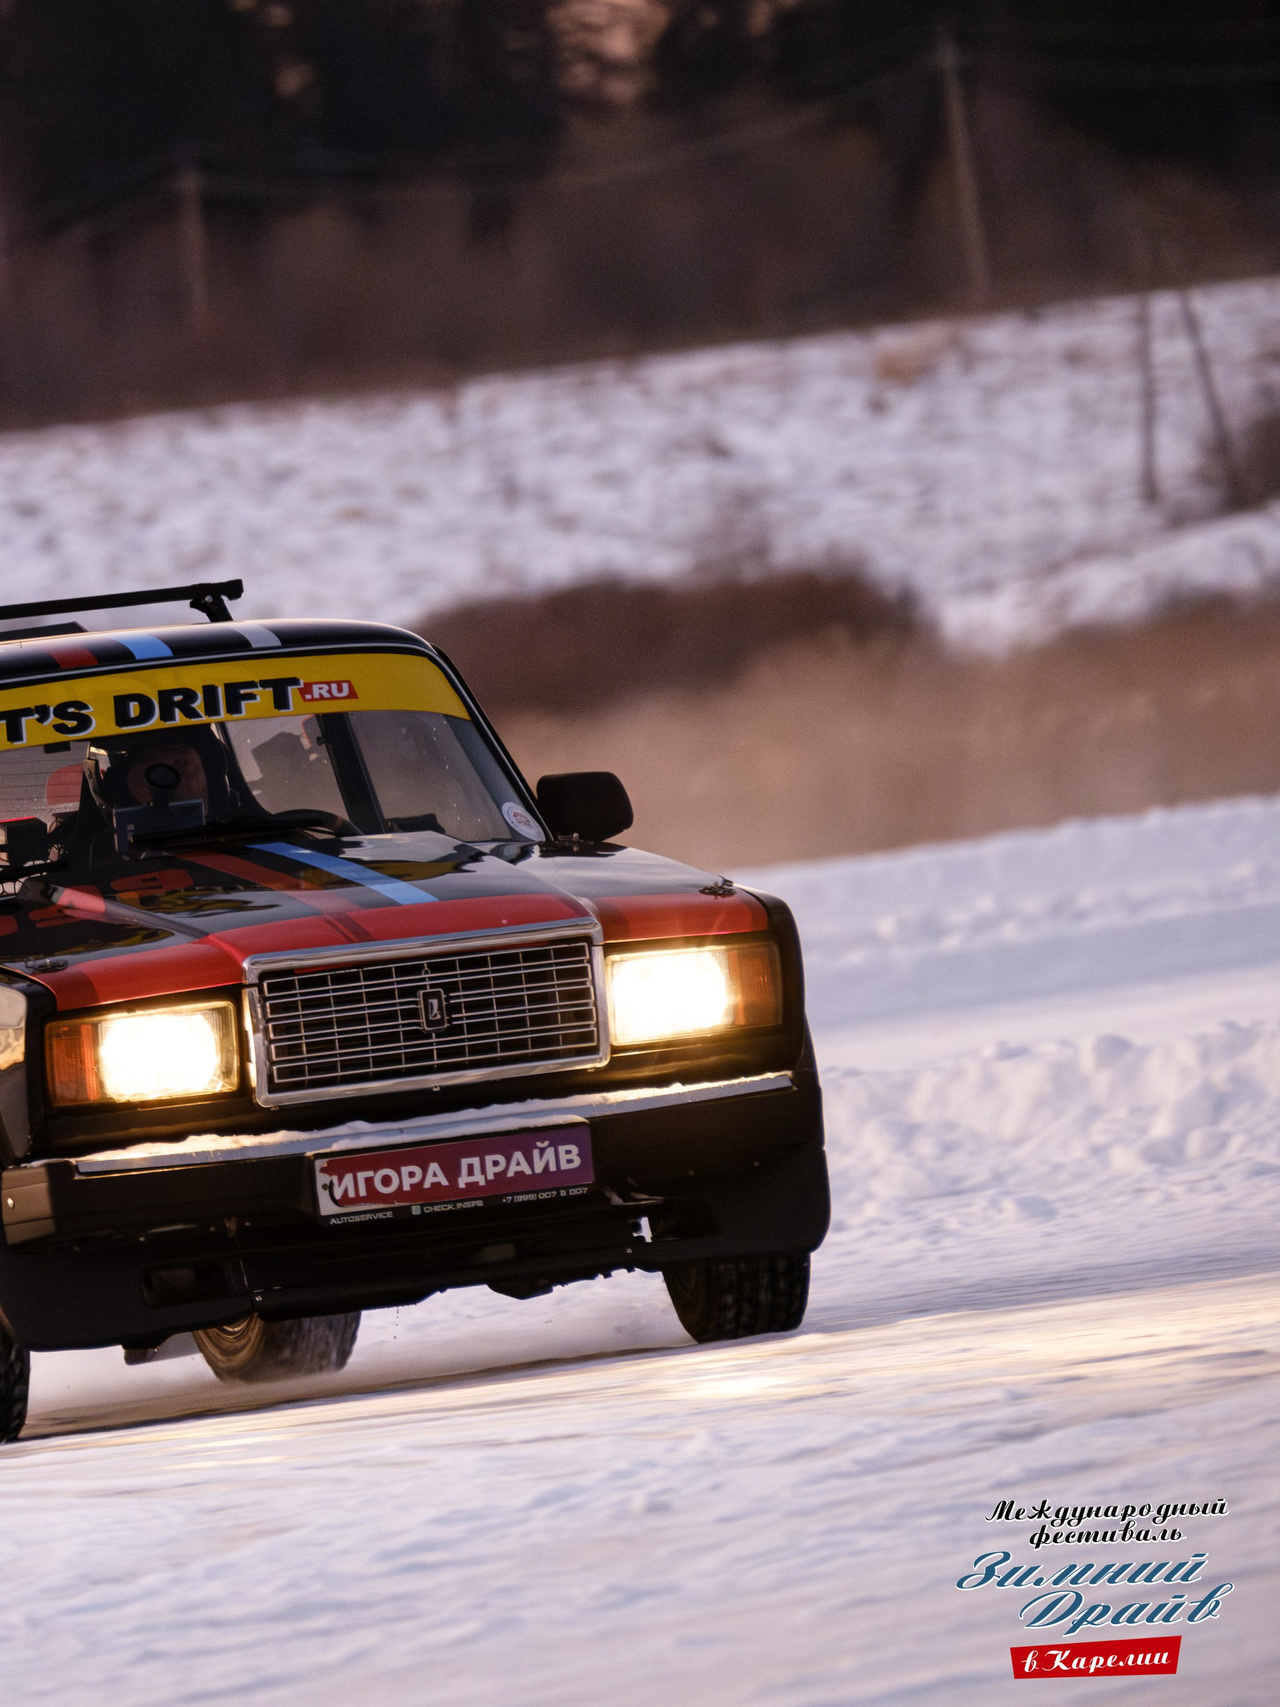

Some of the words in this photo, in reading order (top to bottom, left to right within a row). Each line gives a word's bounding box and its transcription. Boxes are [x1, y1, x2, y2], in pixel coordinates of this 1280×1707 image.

[332, 1161, 449, 1200] ИГОРА
[457, 1140, 582, 1189] ДРАЙВ
[329, 1211, 394, 1226] AUTOSERVICE
